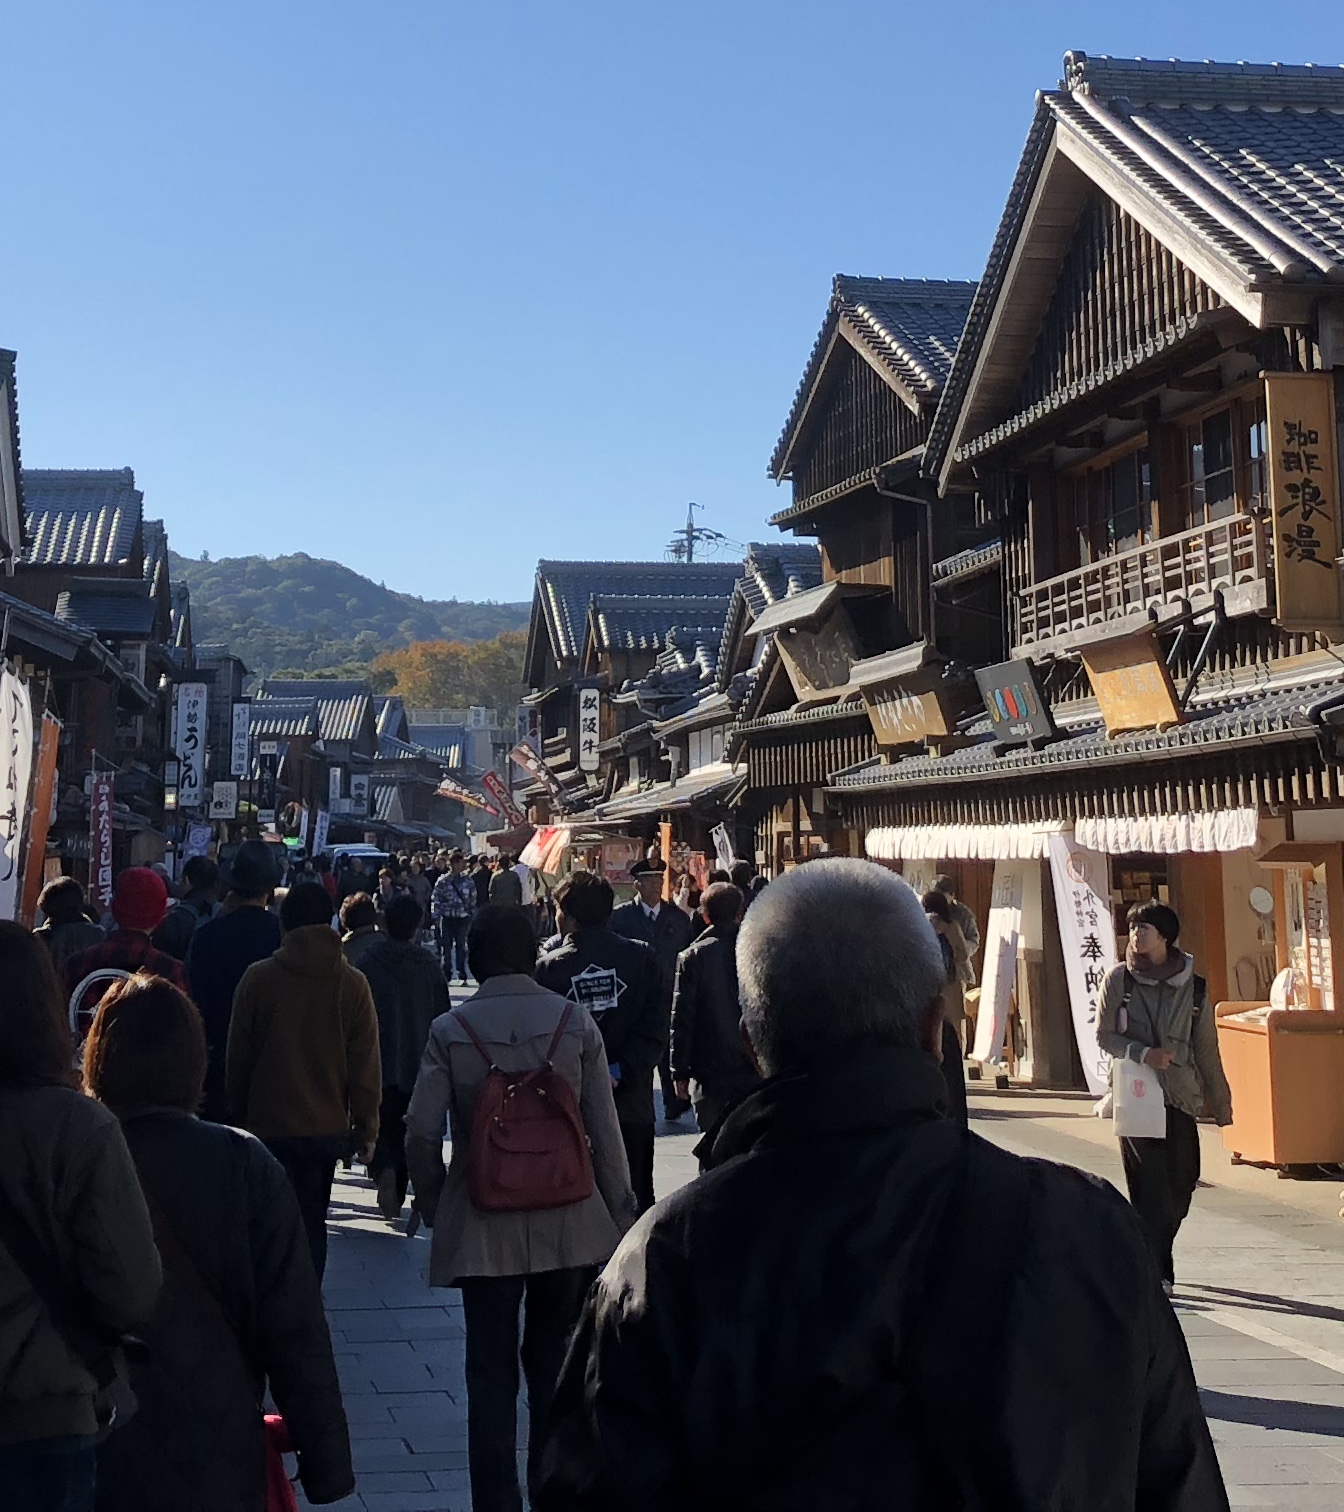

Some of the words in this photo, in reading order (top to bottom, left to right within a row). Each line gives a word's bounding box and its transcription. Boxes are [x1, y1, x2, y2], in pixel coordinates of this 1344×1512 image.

[1278, 418, 1334, 571] 珈琲浪漫
[581, 694, 598, 756] 松阪牛
